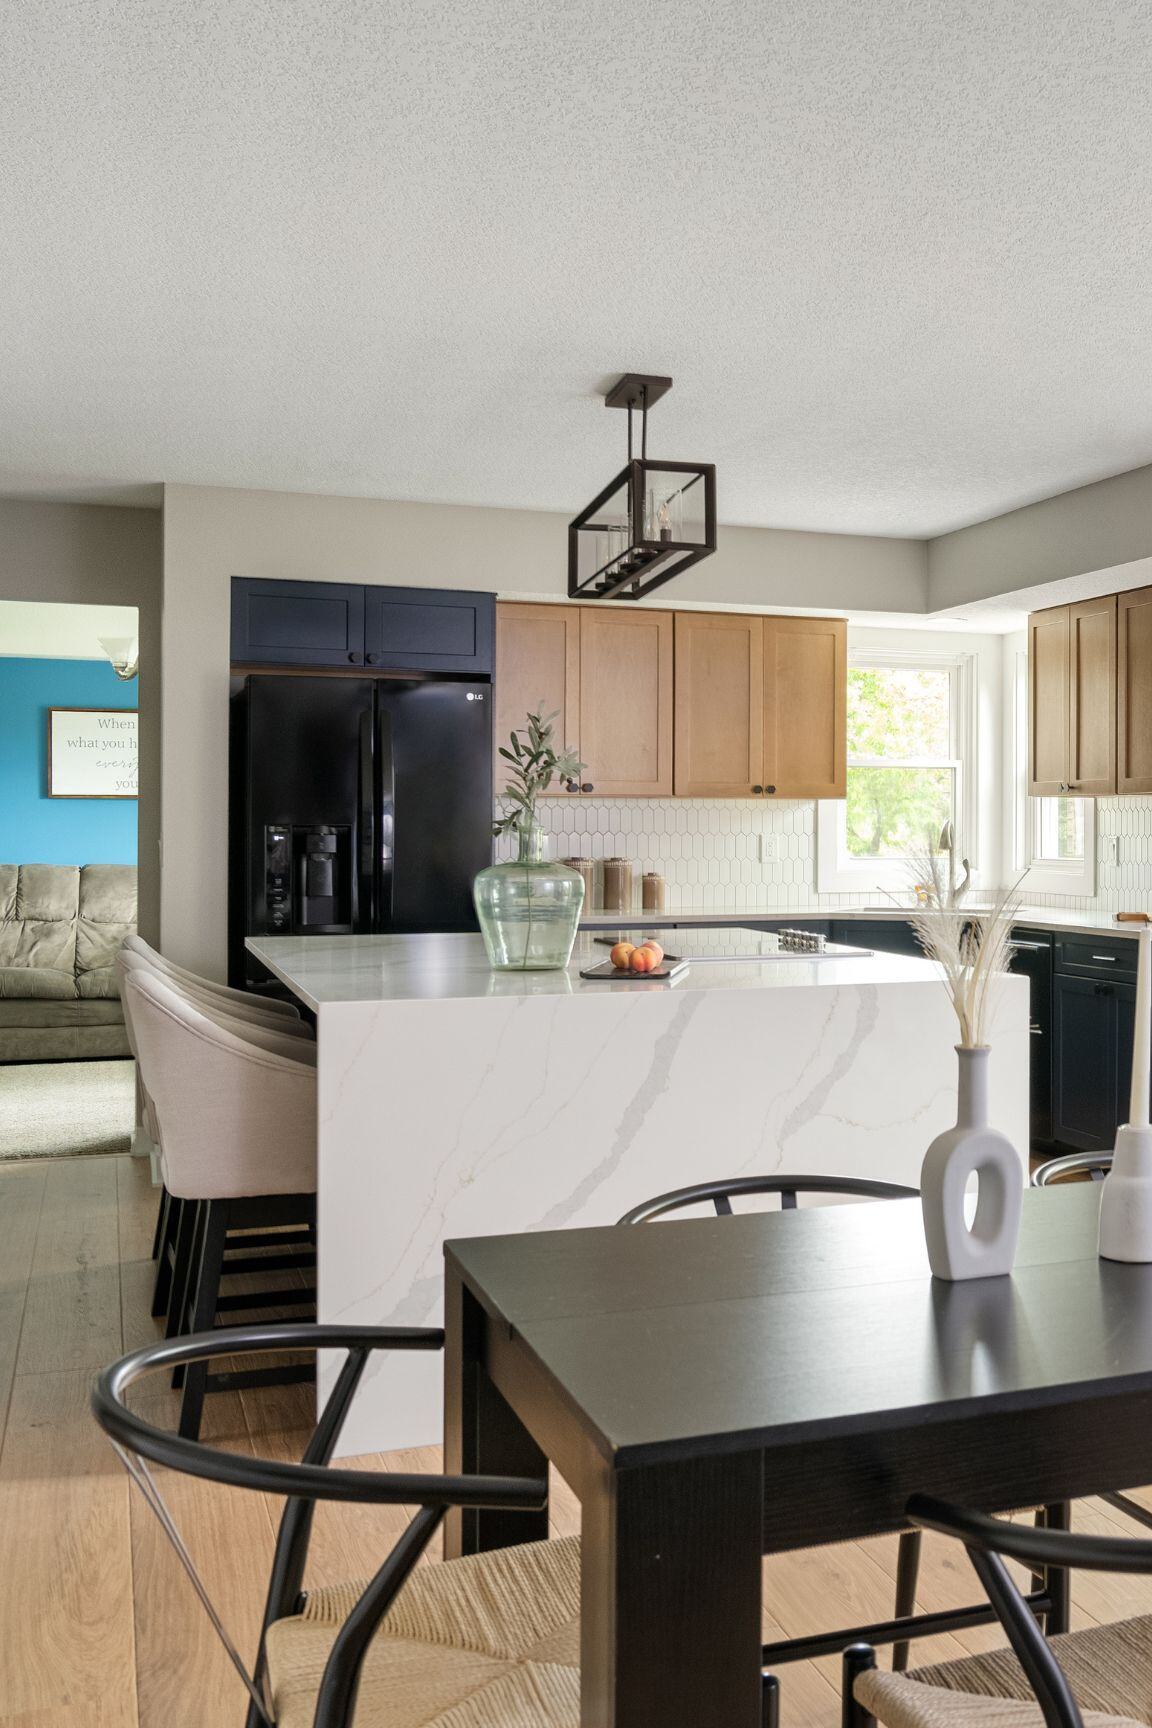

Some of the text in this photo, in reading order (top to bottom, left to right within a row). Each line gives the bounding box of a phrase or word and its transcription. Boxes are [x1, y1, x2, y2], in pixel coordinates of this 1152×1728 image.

[97, 718, 136, 730] When
[67, 736, 138, 752] what you h
[96, 757, 138, 778] every
